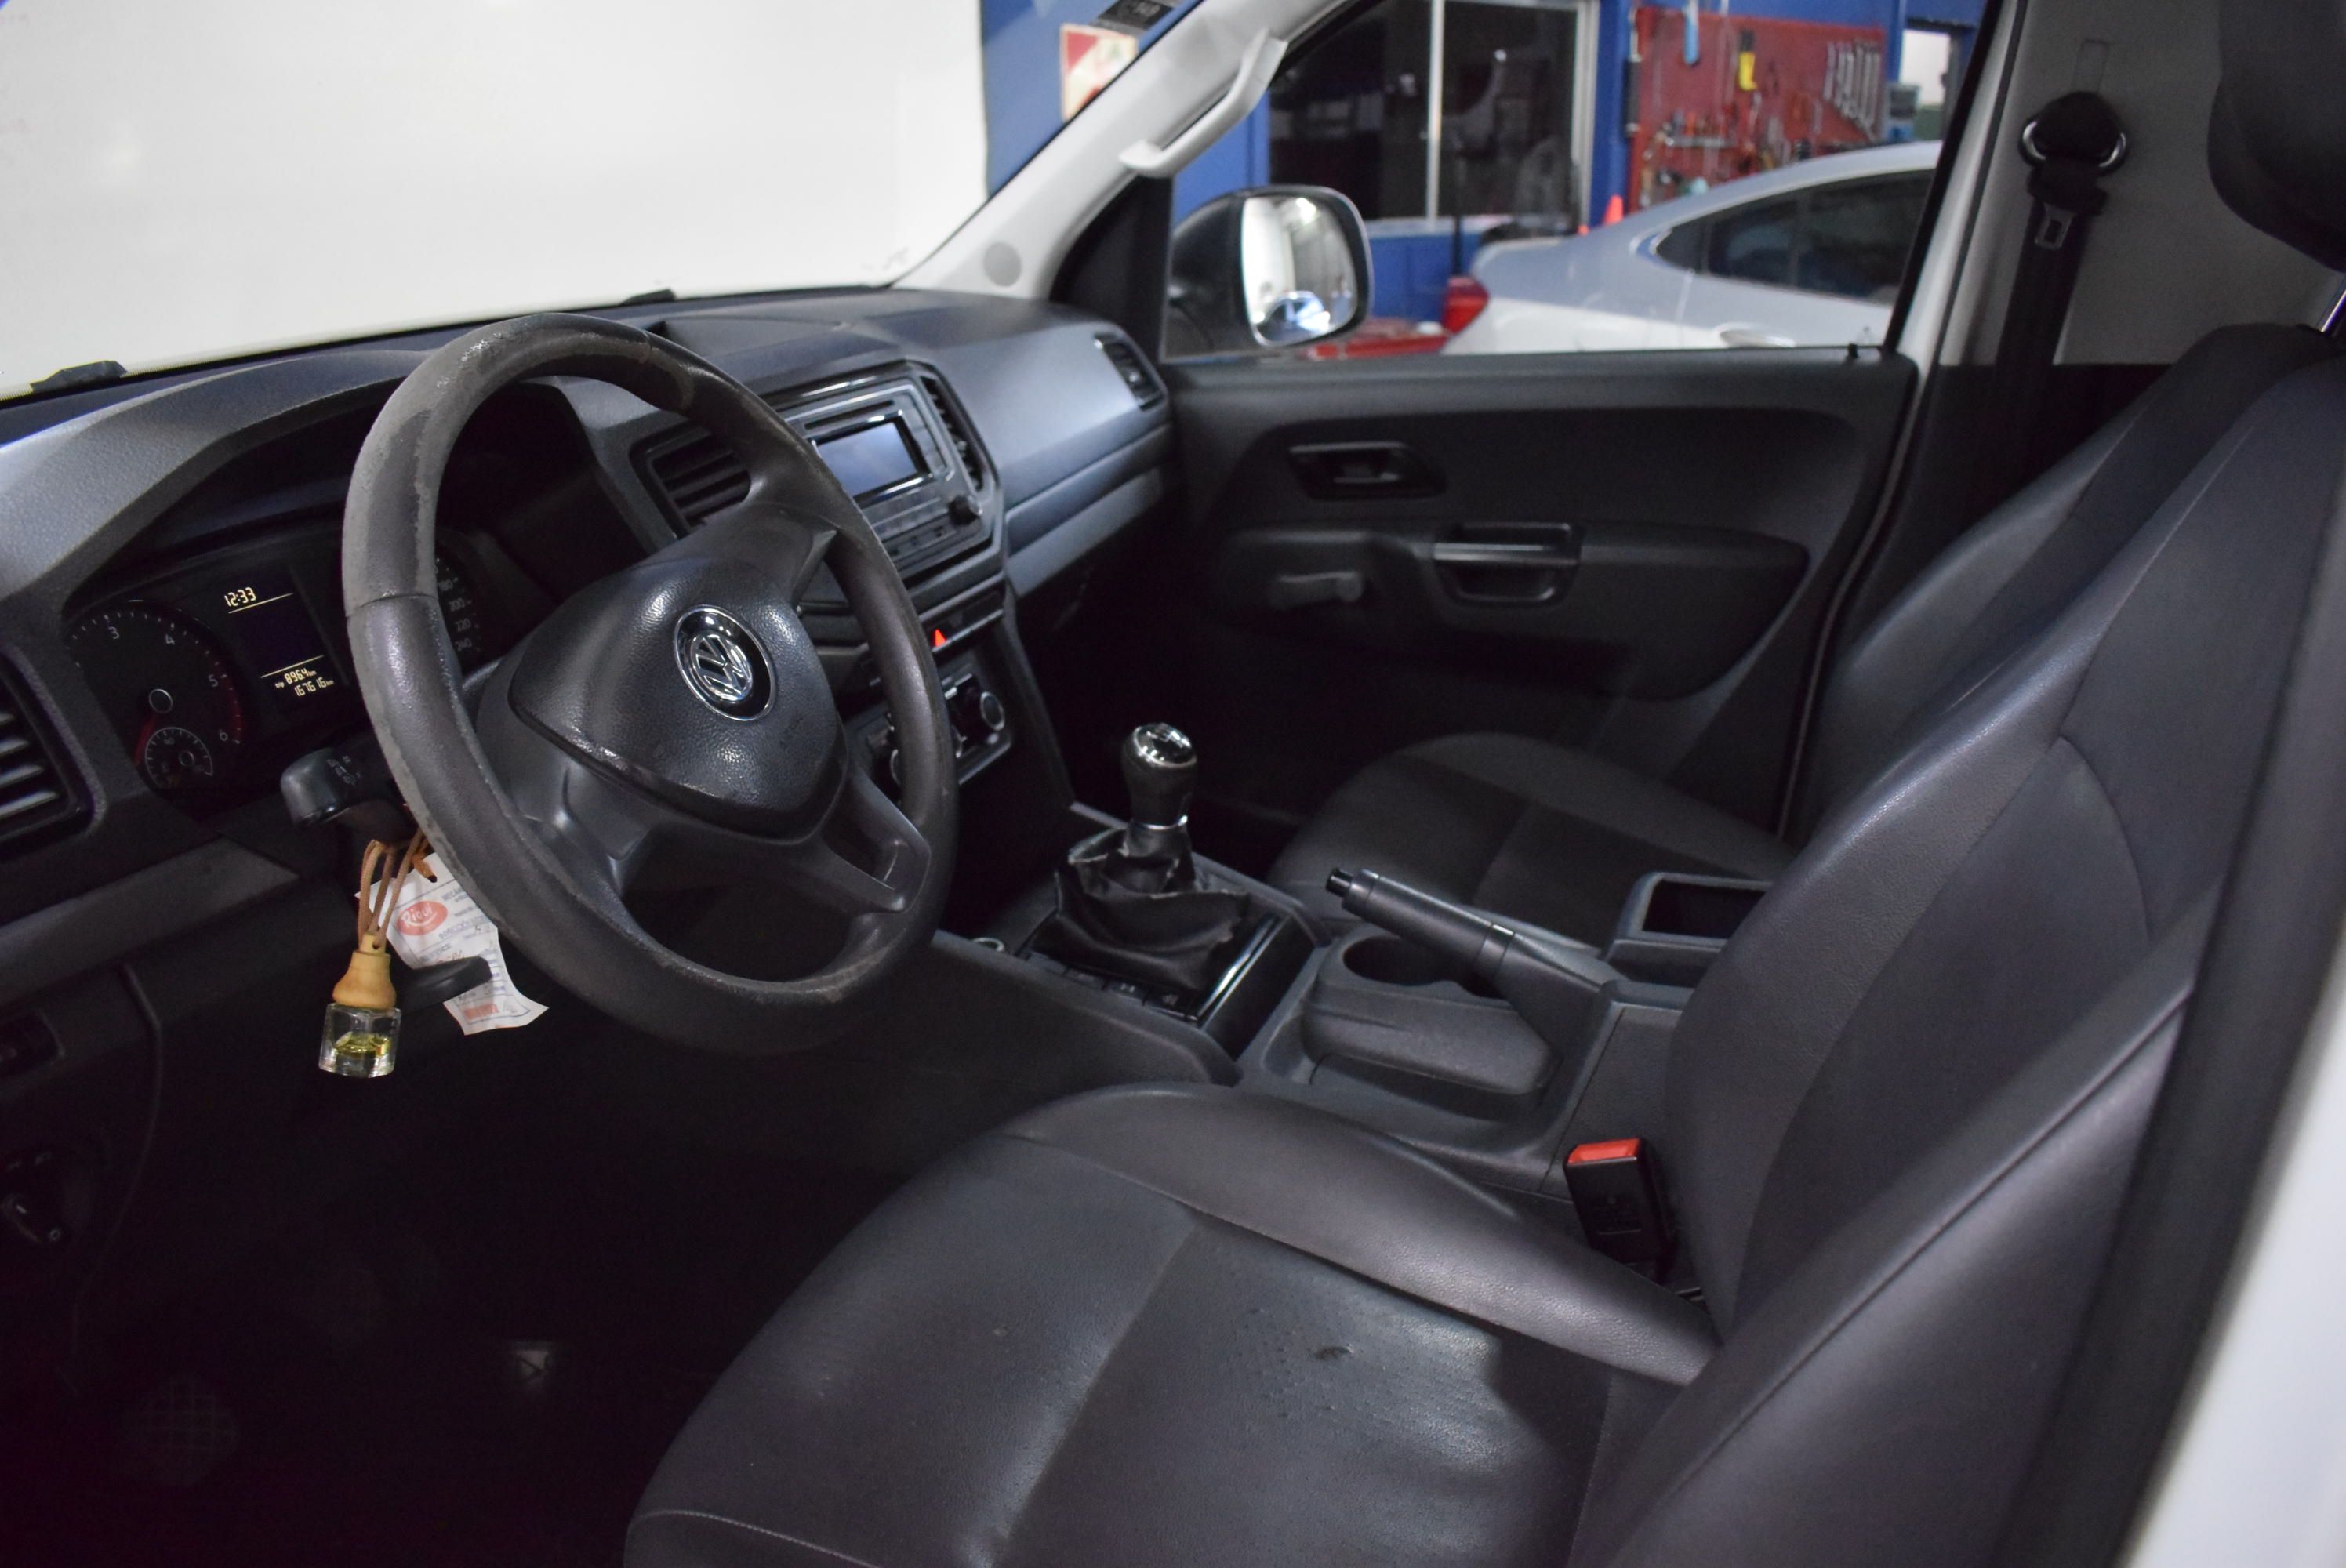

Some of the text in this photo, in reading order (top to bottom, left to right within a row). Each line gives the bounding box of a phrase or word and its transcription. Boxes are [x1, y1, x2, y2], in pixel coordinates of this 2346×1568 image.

[223, 586, 257, 607] 12:33
[107, 626, 120, 640] 3
[165, 633, 176, 645] 4
[208, 674, 219, 688] 5
[219, 729, 229, 742] 6
